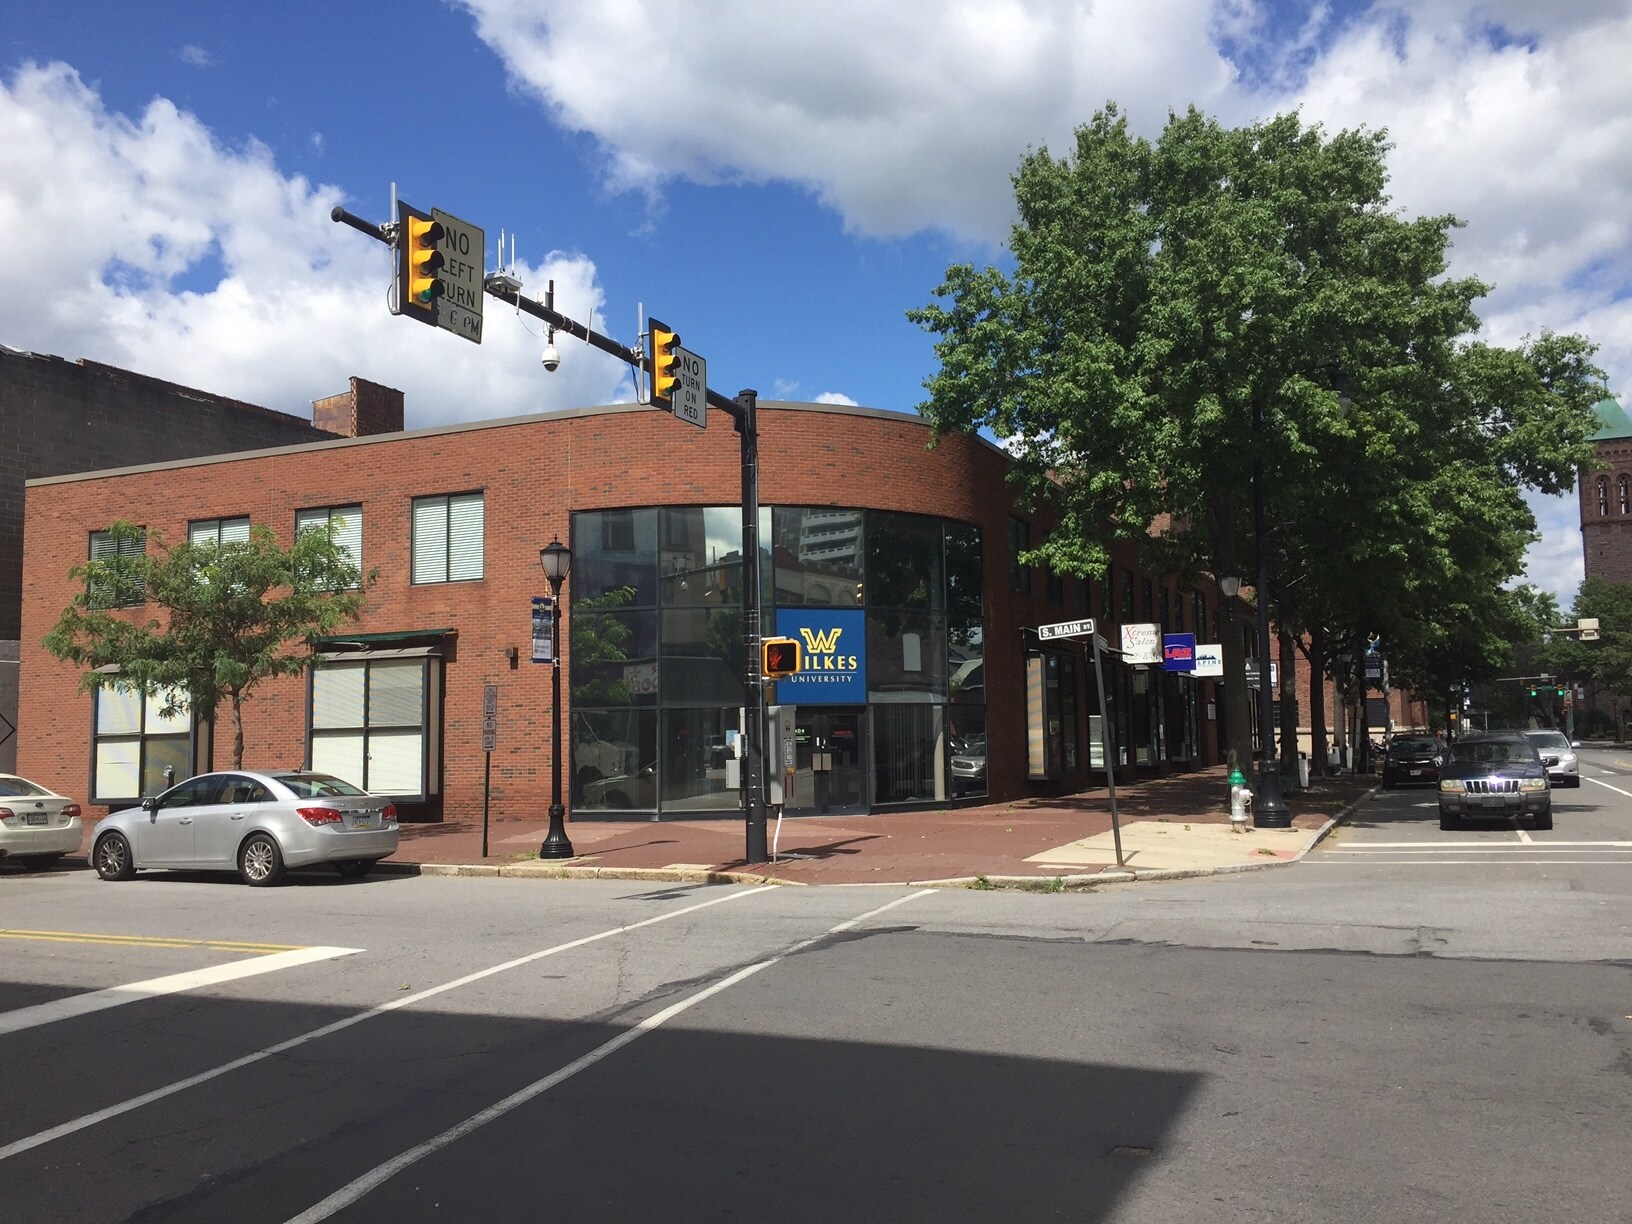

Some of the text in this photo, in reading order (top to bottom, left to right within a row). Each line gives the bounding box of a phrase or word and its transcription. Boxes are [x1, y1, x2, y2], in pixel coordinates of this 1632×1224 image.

[446, 226, 470, 256] NO
[463, 316, 480, 336] PM
[683, 355, 699, 376] NO
[682, 373, 700, 392] TURN
[685, 390, 697, 404] ON
[683, 404, 698, 420] RED
[1042, 628, 1052, 637] S.
[1054, 623, 1081, 636] MAIN
[1126, 637, 1155, 649] Salon
[804, 655, 858, 670] ILKES
[791, 675, 853, 683] UNIVERSITY
